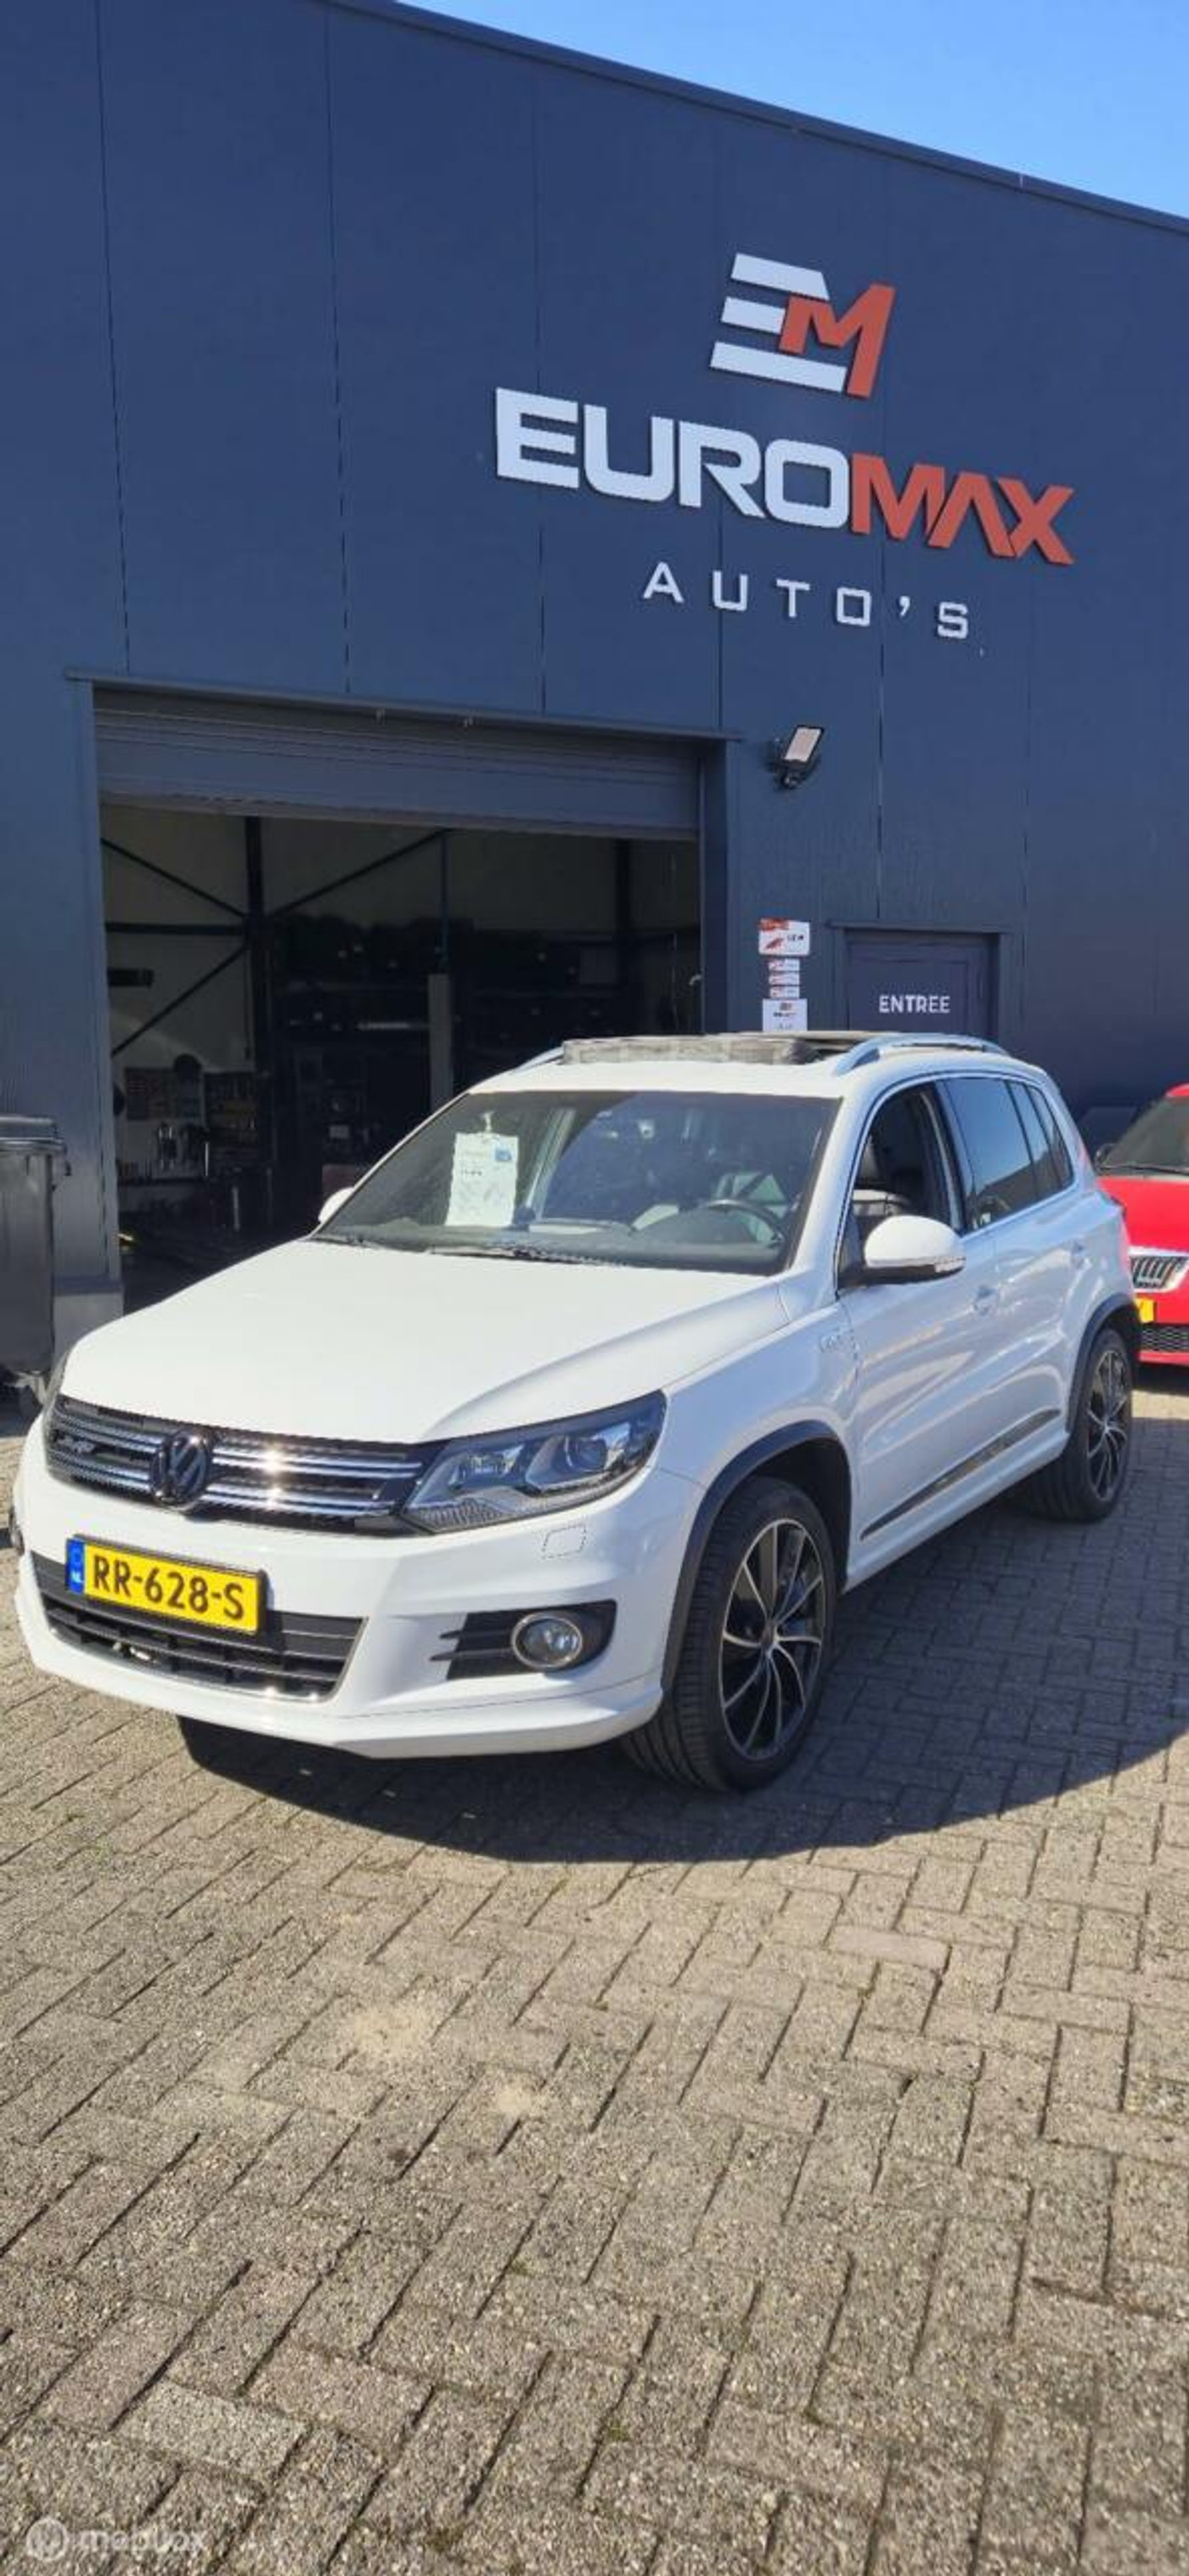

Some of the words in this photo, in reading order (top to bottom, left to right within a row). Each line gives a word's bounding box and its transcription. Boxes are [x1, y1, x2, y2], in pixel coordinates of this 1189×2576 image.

[496, 387, 1075, 566] EUROMAX
[643, 561, 970, 640] AUTO'S
[878, 994, 950, 1014] ENTREE
[93, 1554, 245, 1620] RR-628-S
